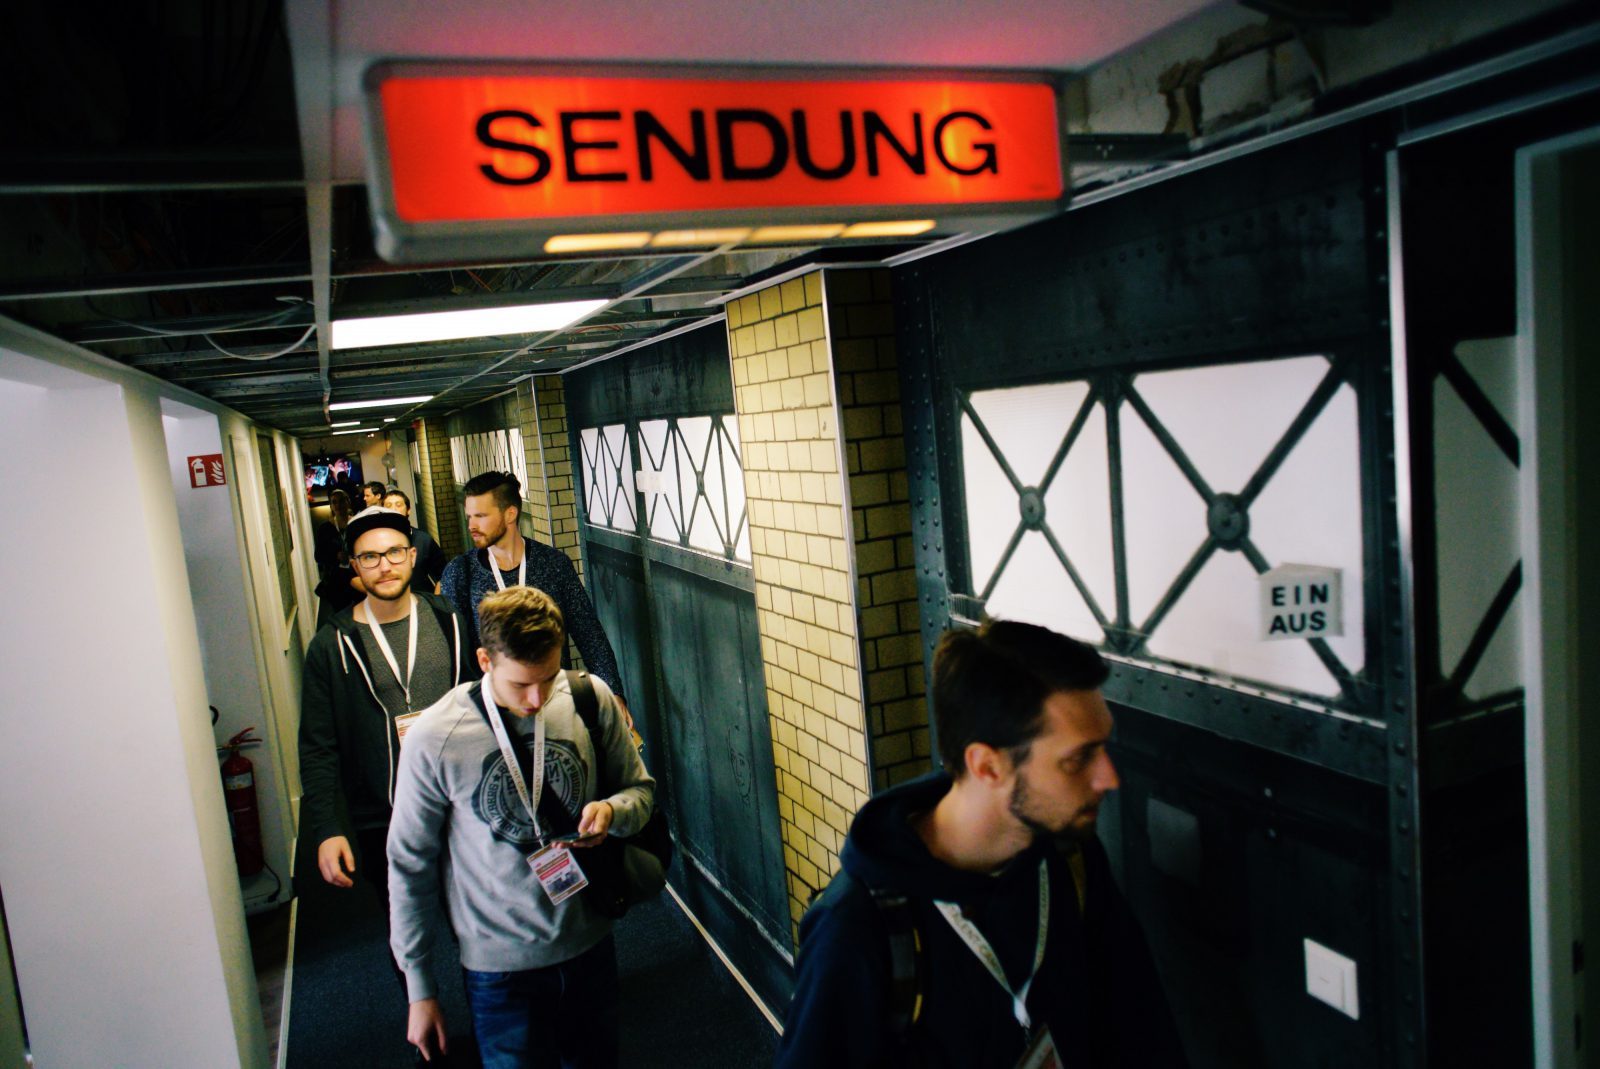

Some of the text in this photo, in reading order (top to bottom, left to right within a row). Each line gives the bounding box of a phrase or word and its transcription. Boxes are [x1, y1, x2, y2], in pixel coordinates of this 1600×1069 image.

[474, 108, 999, 187] SENDUNG
[1271, 583, 1329, 607] EIN
[1268, 610, 1328, 635] AUS
